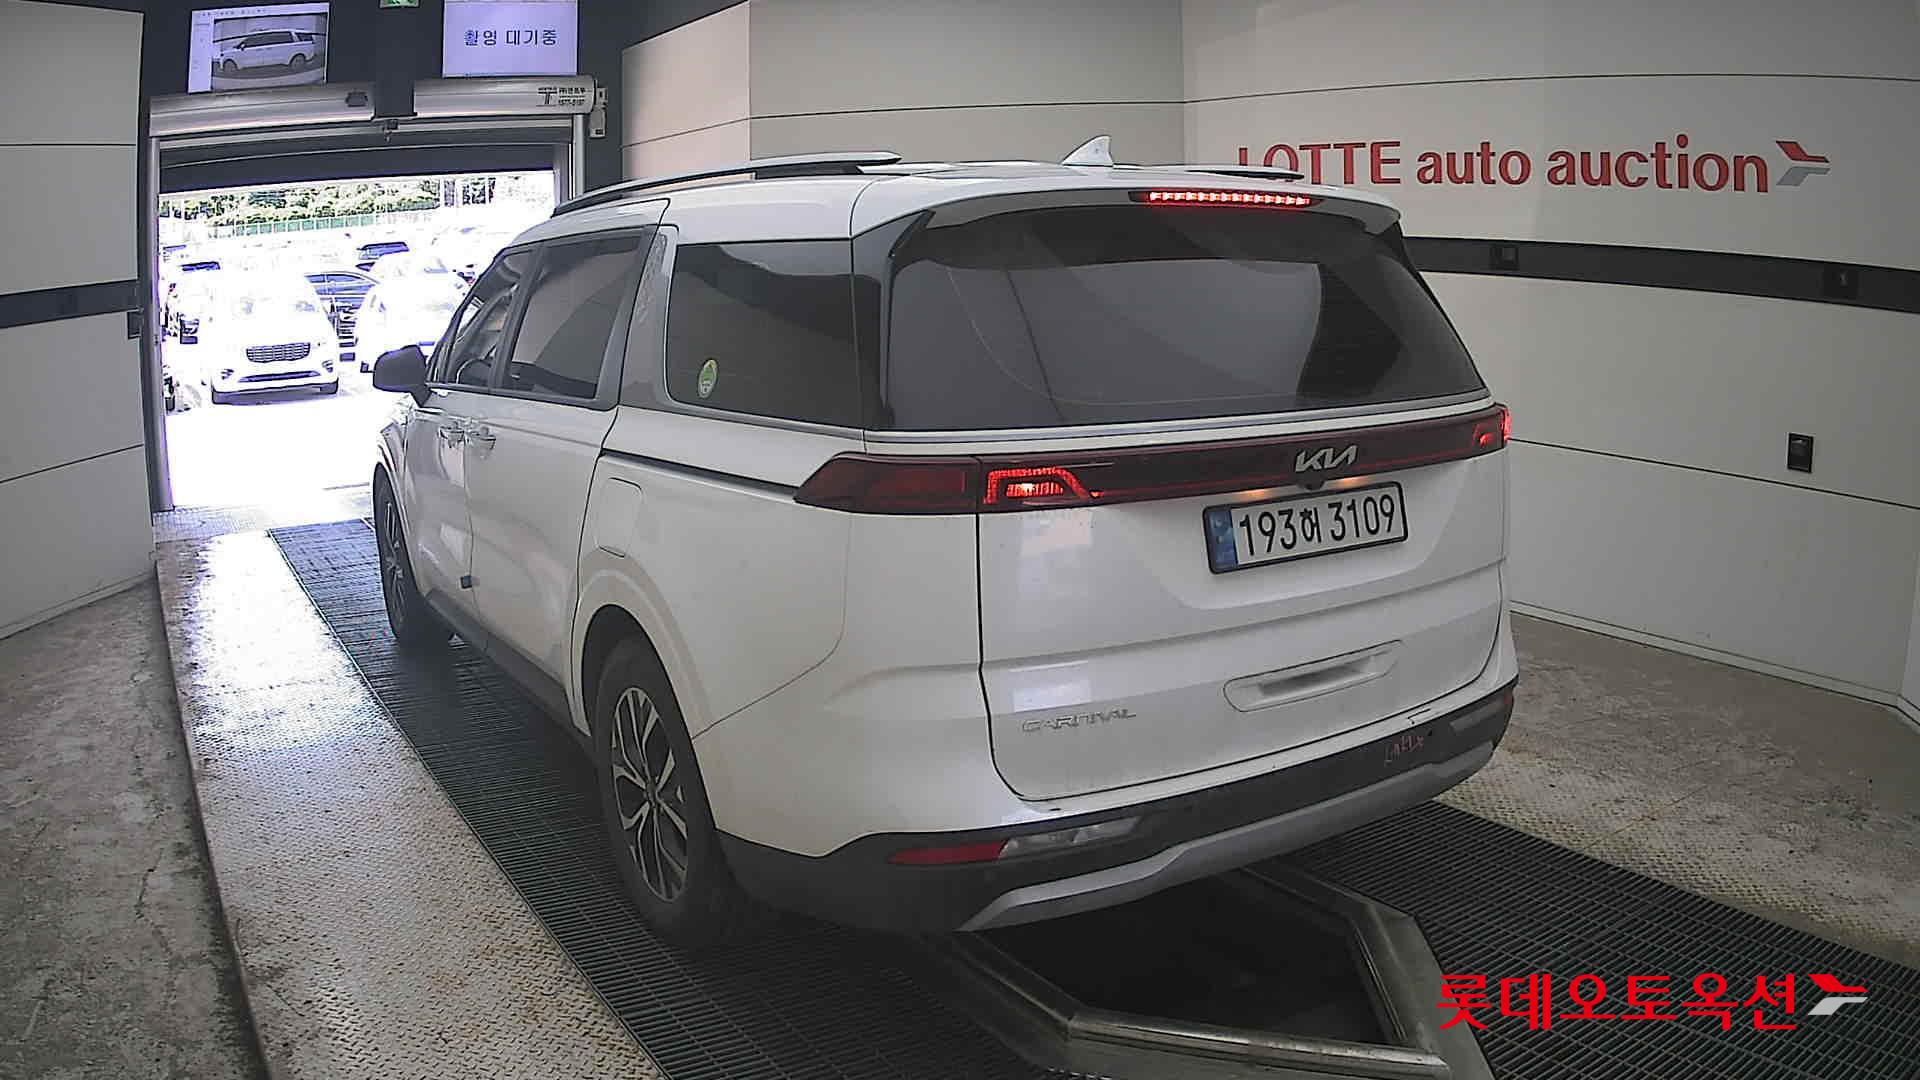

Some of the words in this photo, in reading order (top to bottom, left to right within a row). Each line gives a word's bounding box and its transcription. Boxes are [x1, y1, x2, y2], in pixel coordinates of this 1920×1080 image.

[465, 29, 497, 46] 촬영
[505, 29, 557, 46] 대기중
[1417, 141, 1532, 185] auto
[1547, 134, 1769, 193] auction
[1295, 444, 1358, 473] KIA
[1239, 506, 1322, 556] 193허
[1328, 494, 1395, 541] 3109
